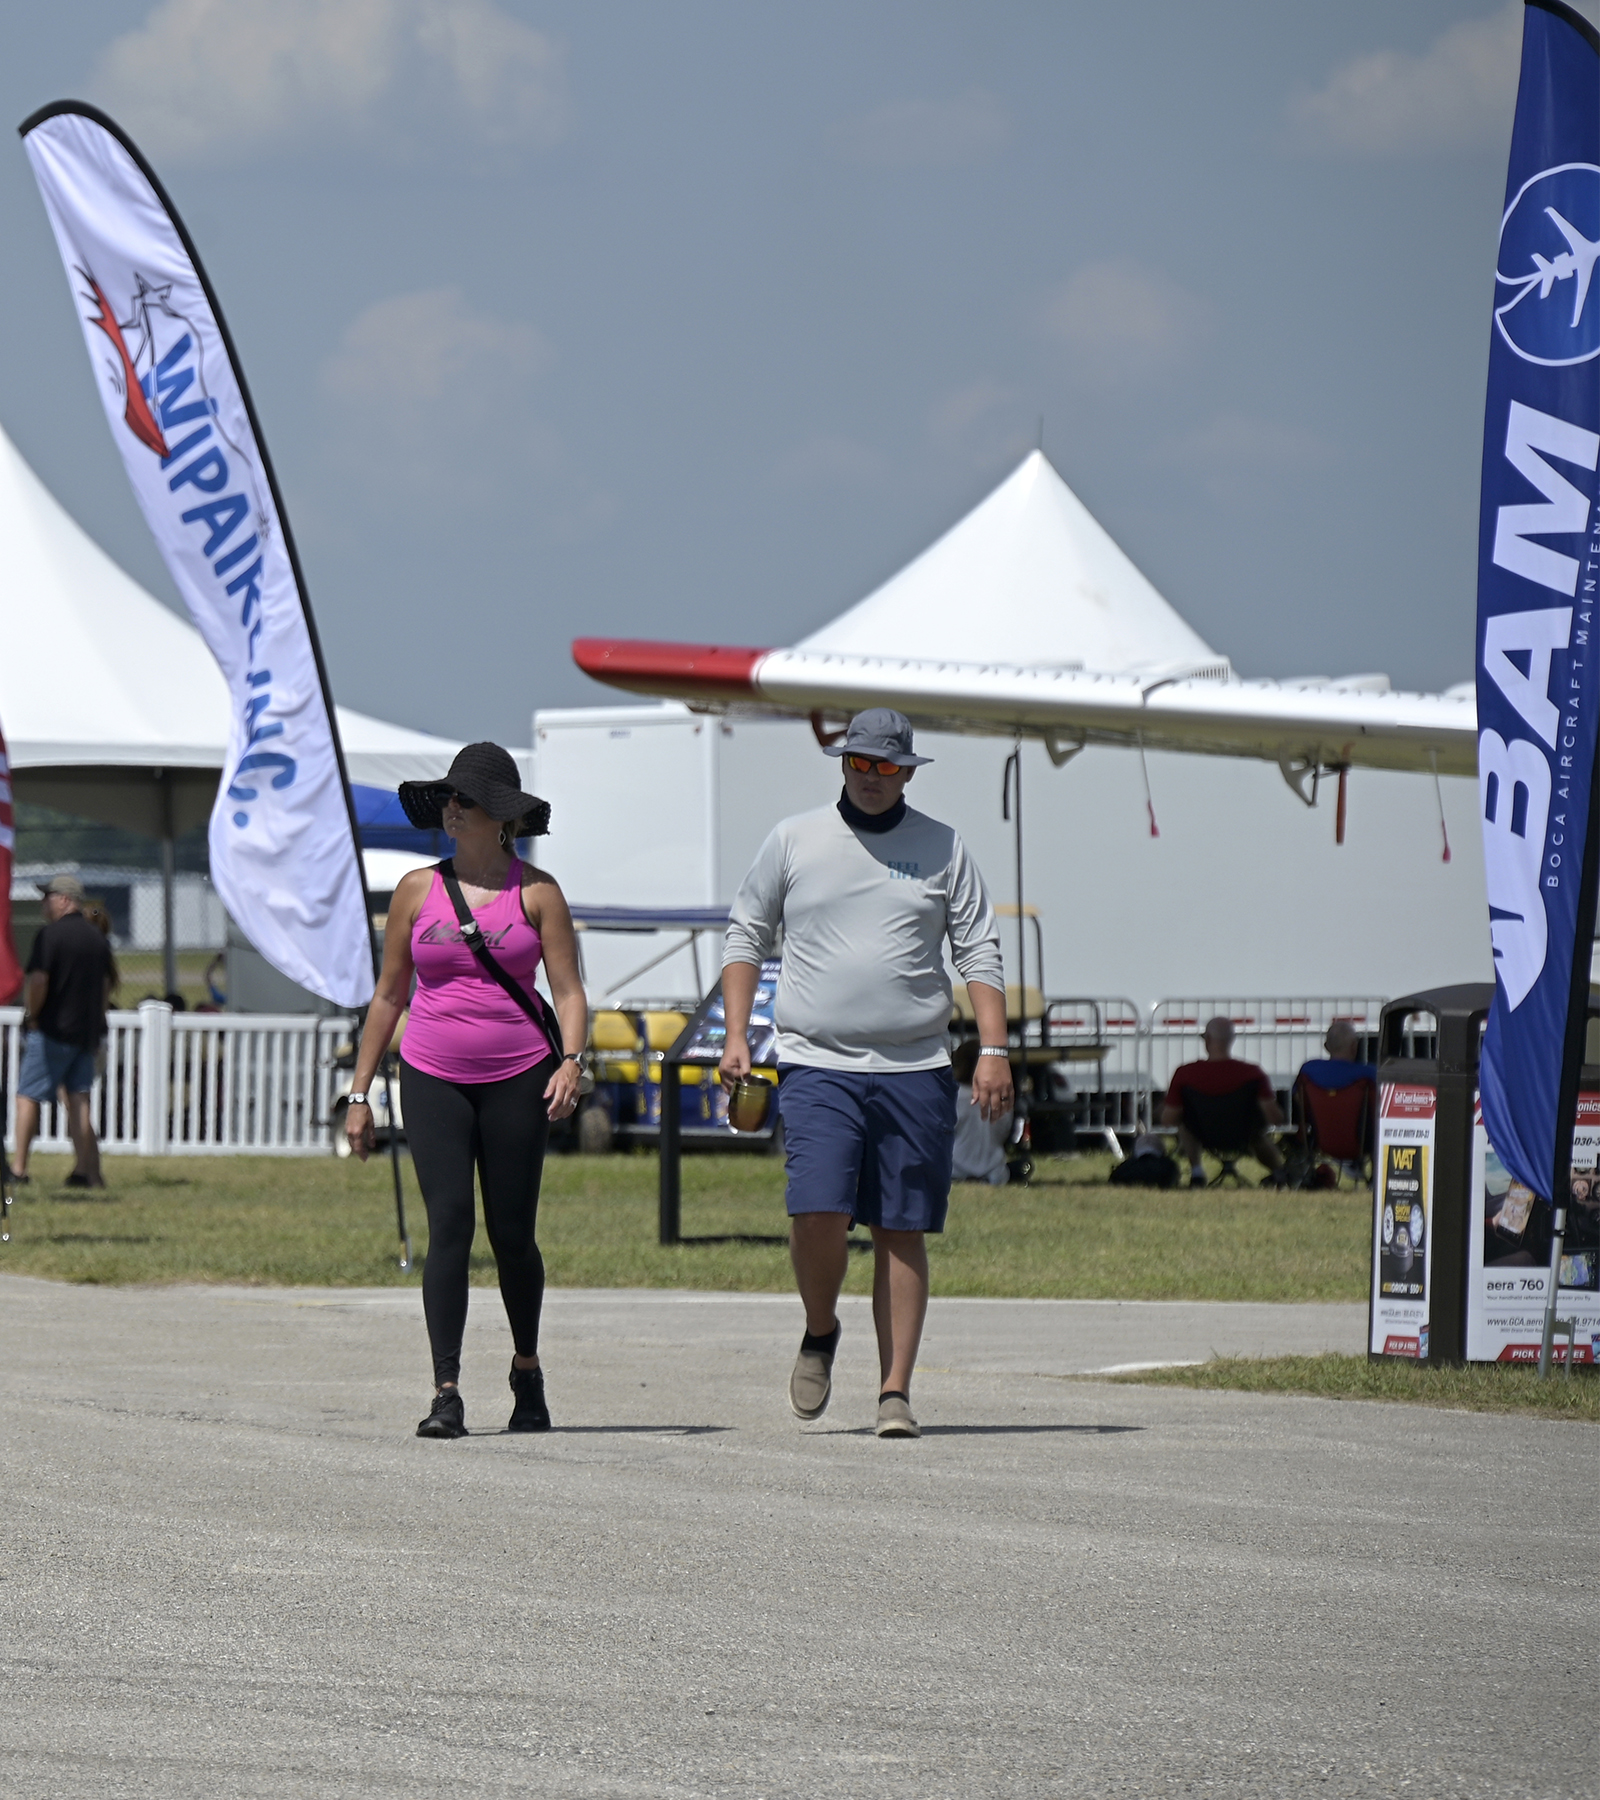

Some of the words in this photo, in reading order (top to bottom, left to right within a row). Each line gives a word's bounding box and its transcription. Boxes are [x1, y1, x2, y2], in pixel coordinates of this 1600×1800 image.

[1546, 813, 1568, 888] BOCA
[1557, 659, 1584, 800] AIRCRAFT
[1575, 505, 1600, 647] MAINTEN
[1578, 1101, 1600, 1112] onics
[1393, 1148, 1417, 1171] WAT
[1572, 1157, 1593, 1165] RMIN
[1388, 1179, 1409, 1191] PREMIUM
[1409, 1179, 1419, 1192] LED
[1486, 1281, 1515, 1291] aera
[1519, 1279, 1544, 1291] 760
[1512, 1349, 1535, 1359] PICK
[1552, 1350, 1559, 1359] A
[1561, 1350, 1585, 1359] FEE
